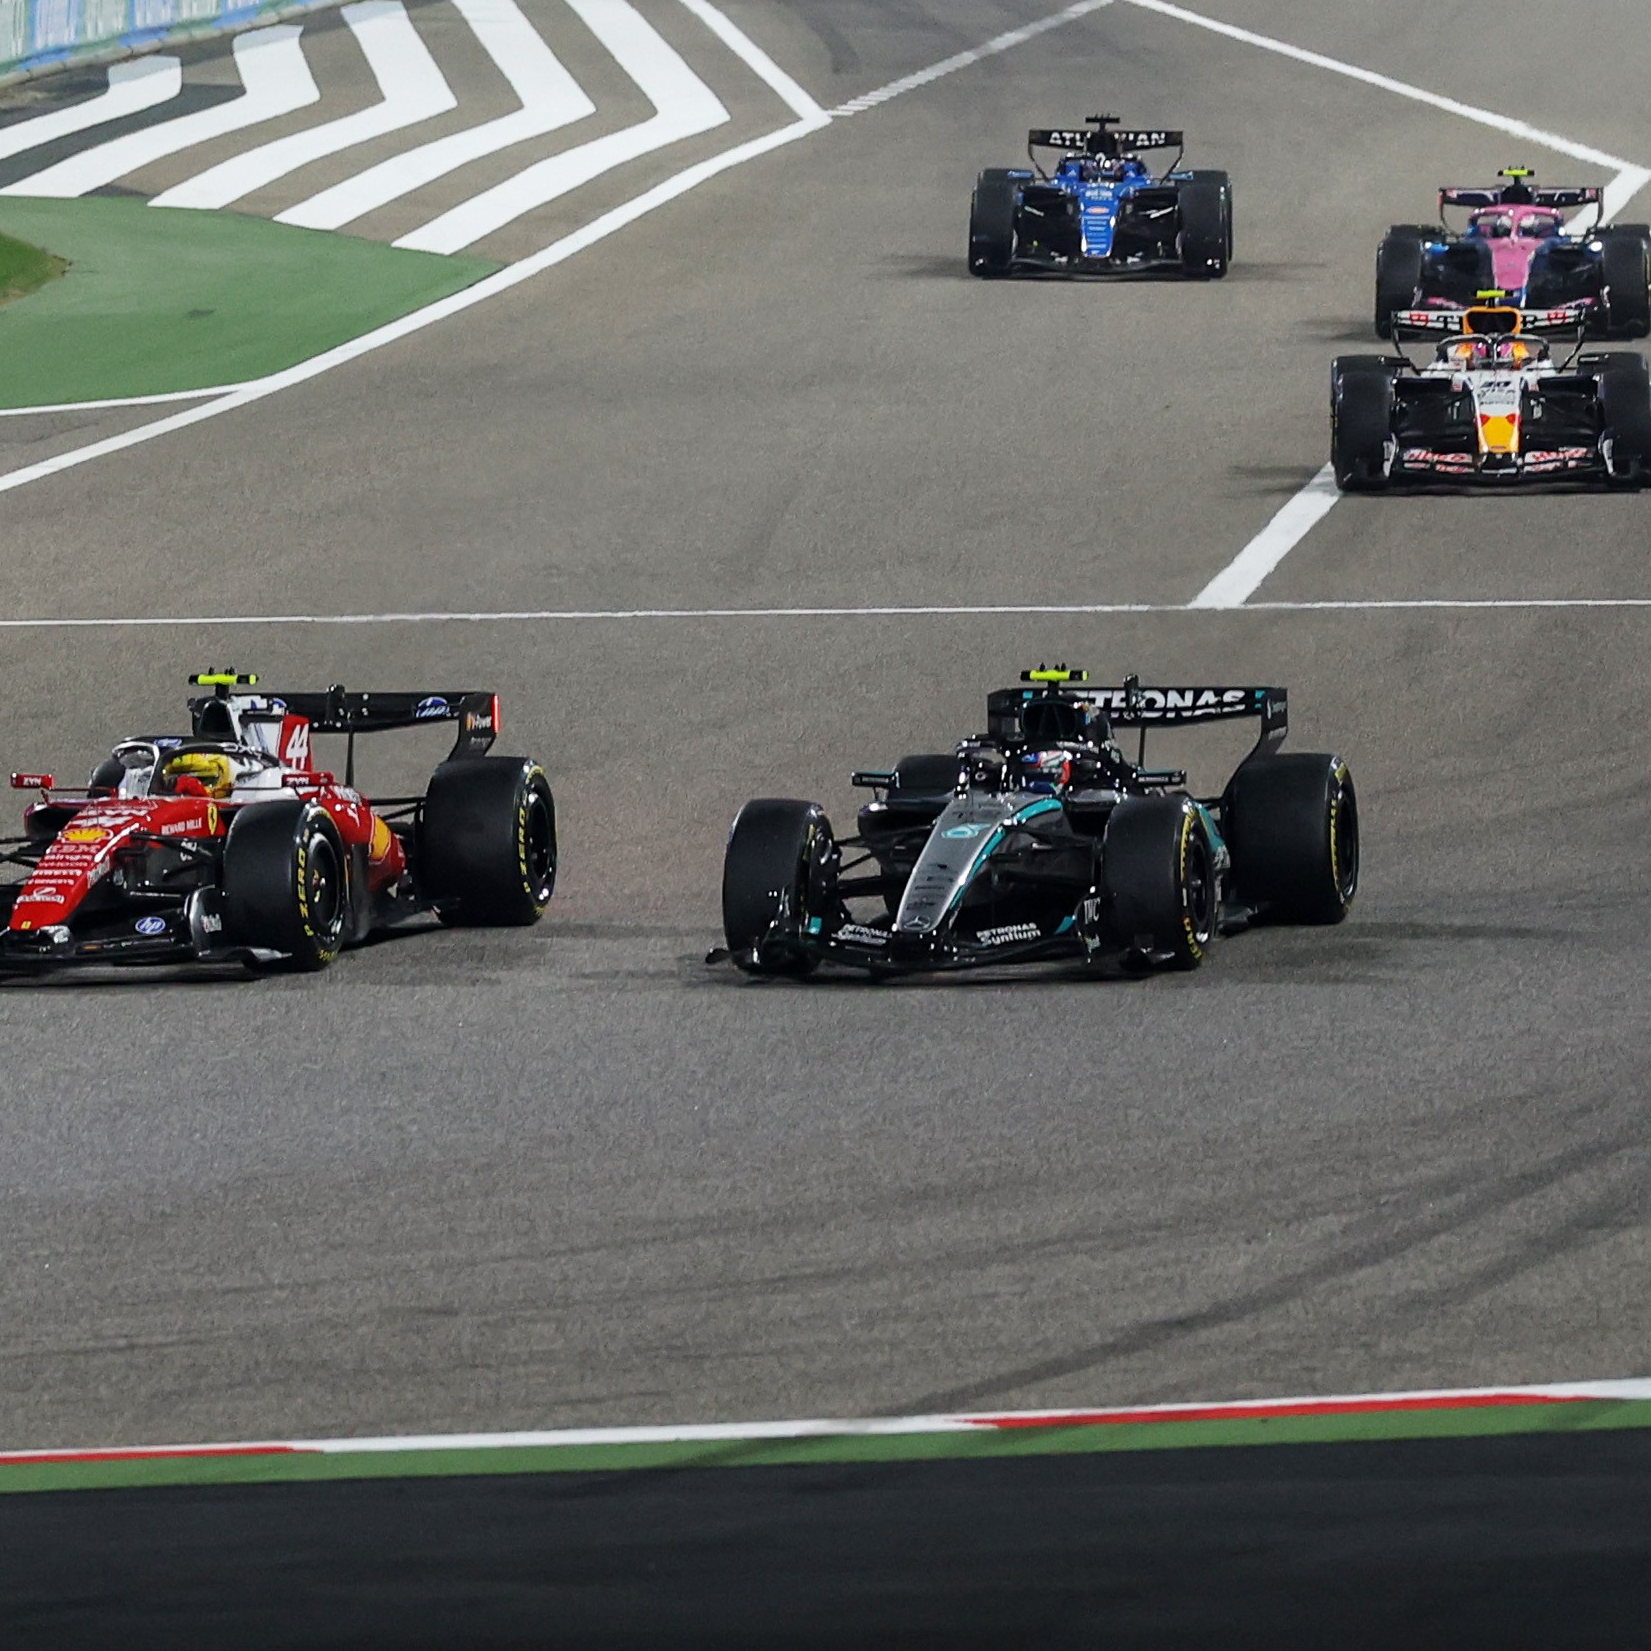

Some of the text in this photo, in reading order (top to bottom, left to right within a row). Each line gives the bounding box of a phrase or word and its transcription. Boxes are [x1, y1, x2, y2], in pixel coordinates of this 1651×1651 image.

[285, 723, 309, 770] 44
[160, 817, 203, 836] RICHARD MILLE
[977, 922, 1037, 936] PETRONAS
